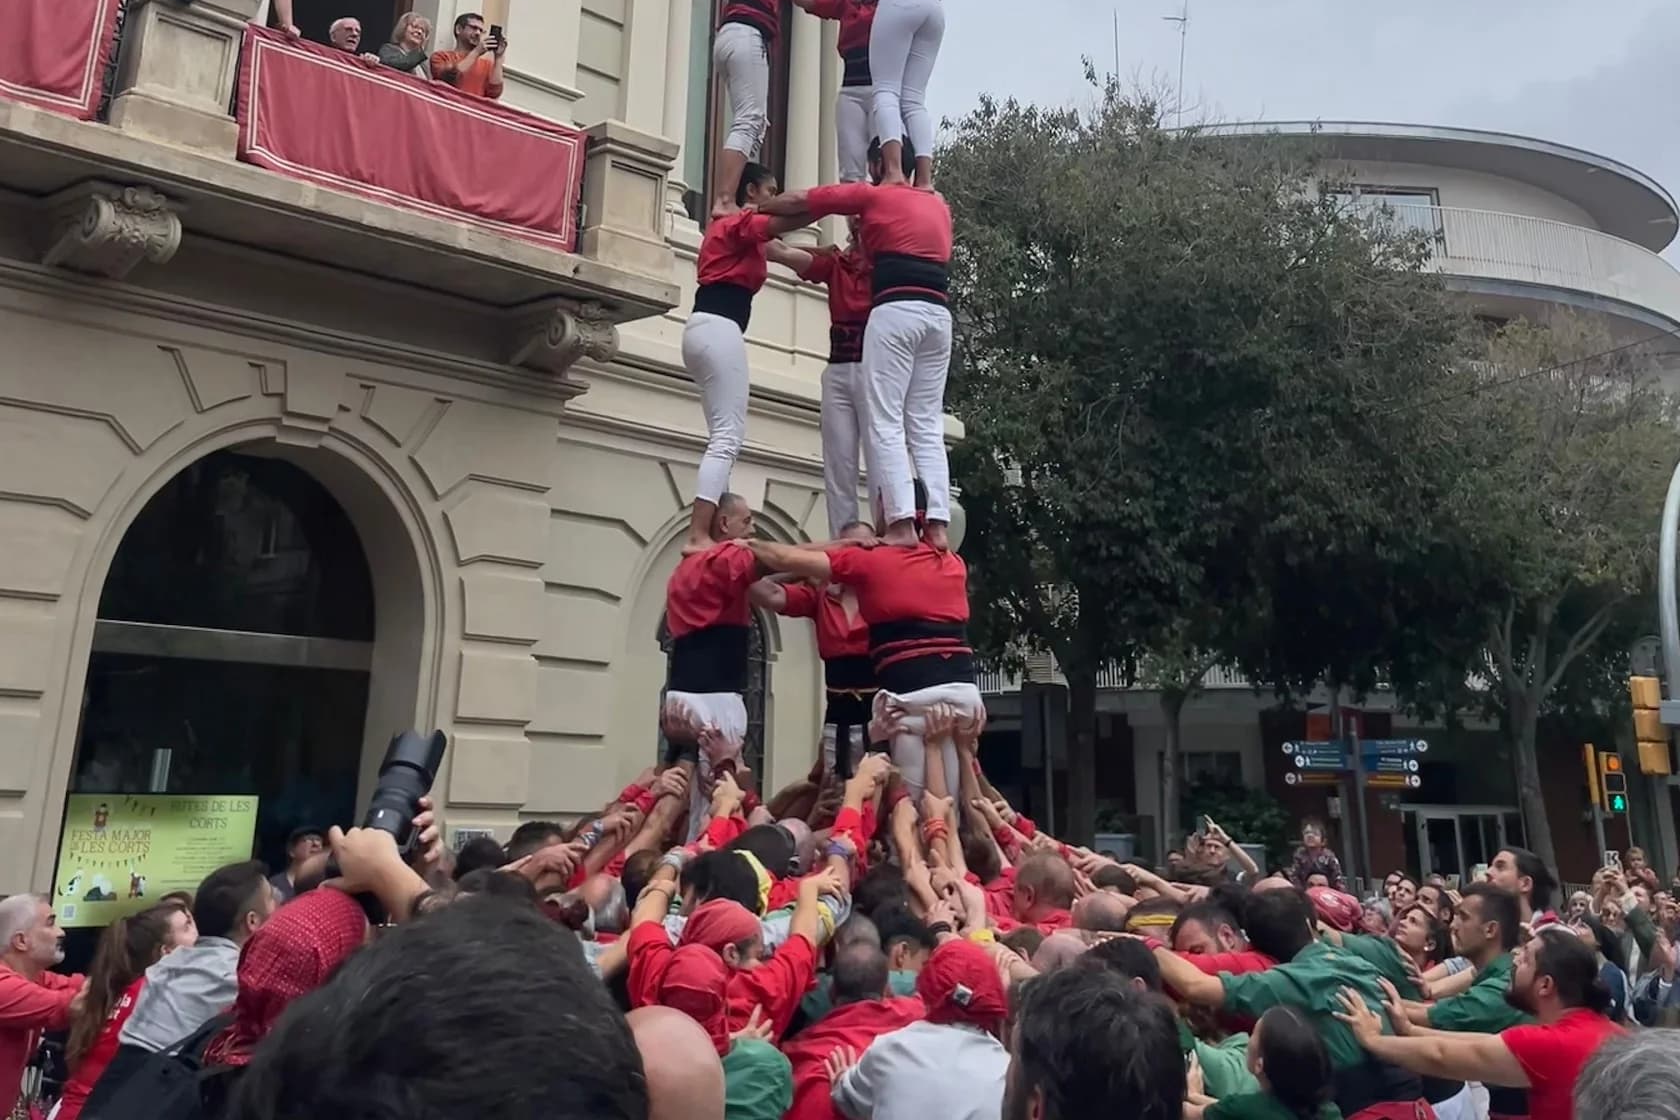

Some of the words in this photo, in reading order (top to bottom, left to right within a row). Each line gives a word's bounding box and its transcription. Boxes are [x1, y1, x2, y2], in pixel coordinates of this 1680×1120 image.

[211, 800, 226, 812] DE
[229, 800, 250, 812] LES
[190, 816, 228, 829] CORTS
[71, 829, 107, 841] FESTA
[112, 829, 151, 841] MAJOR
[80, 840, 105, 854] LES
[108, 840, 151, 854] CORTS
